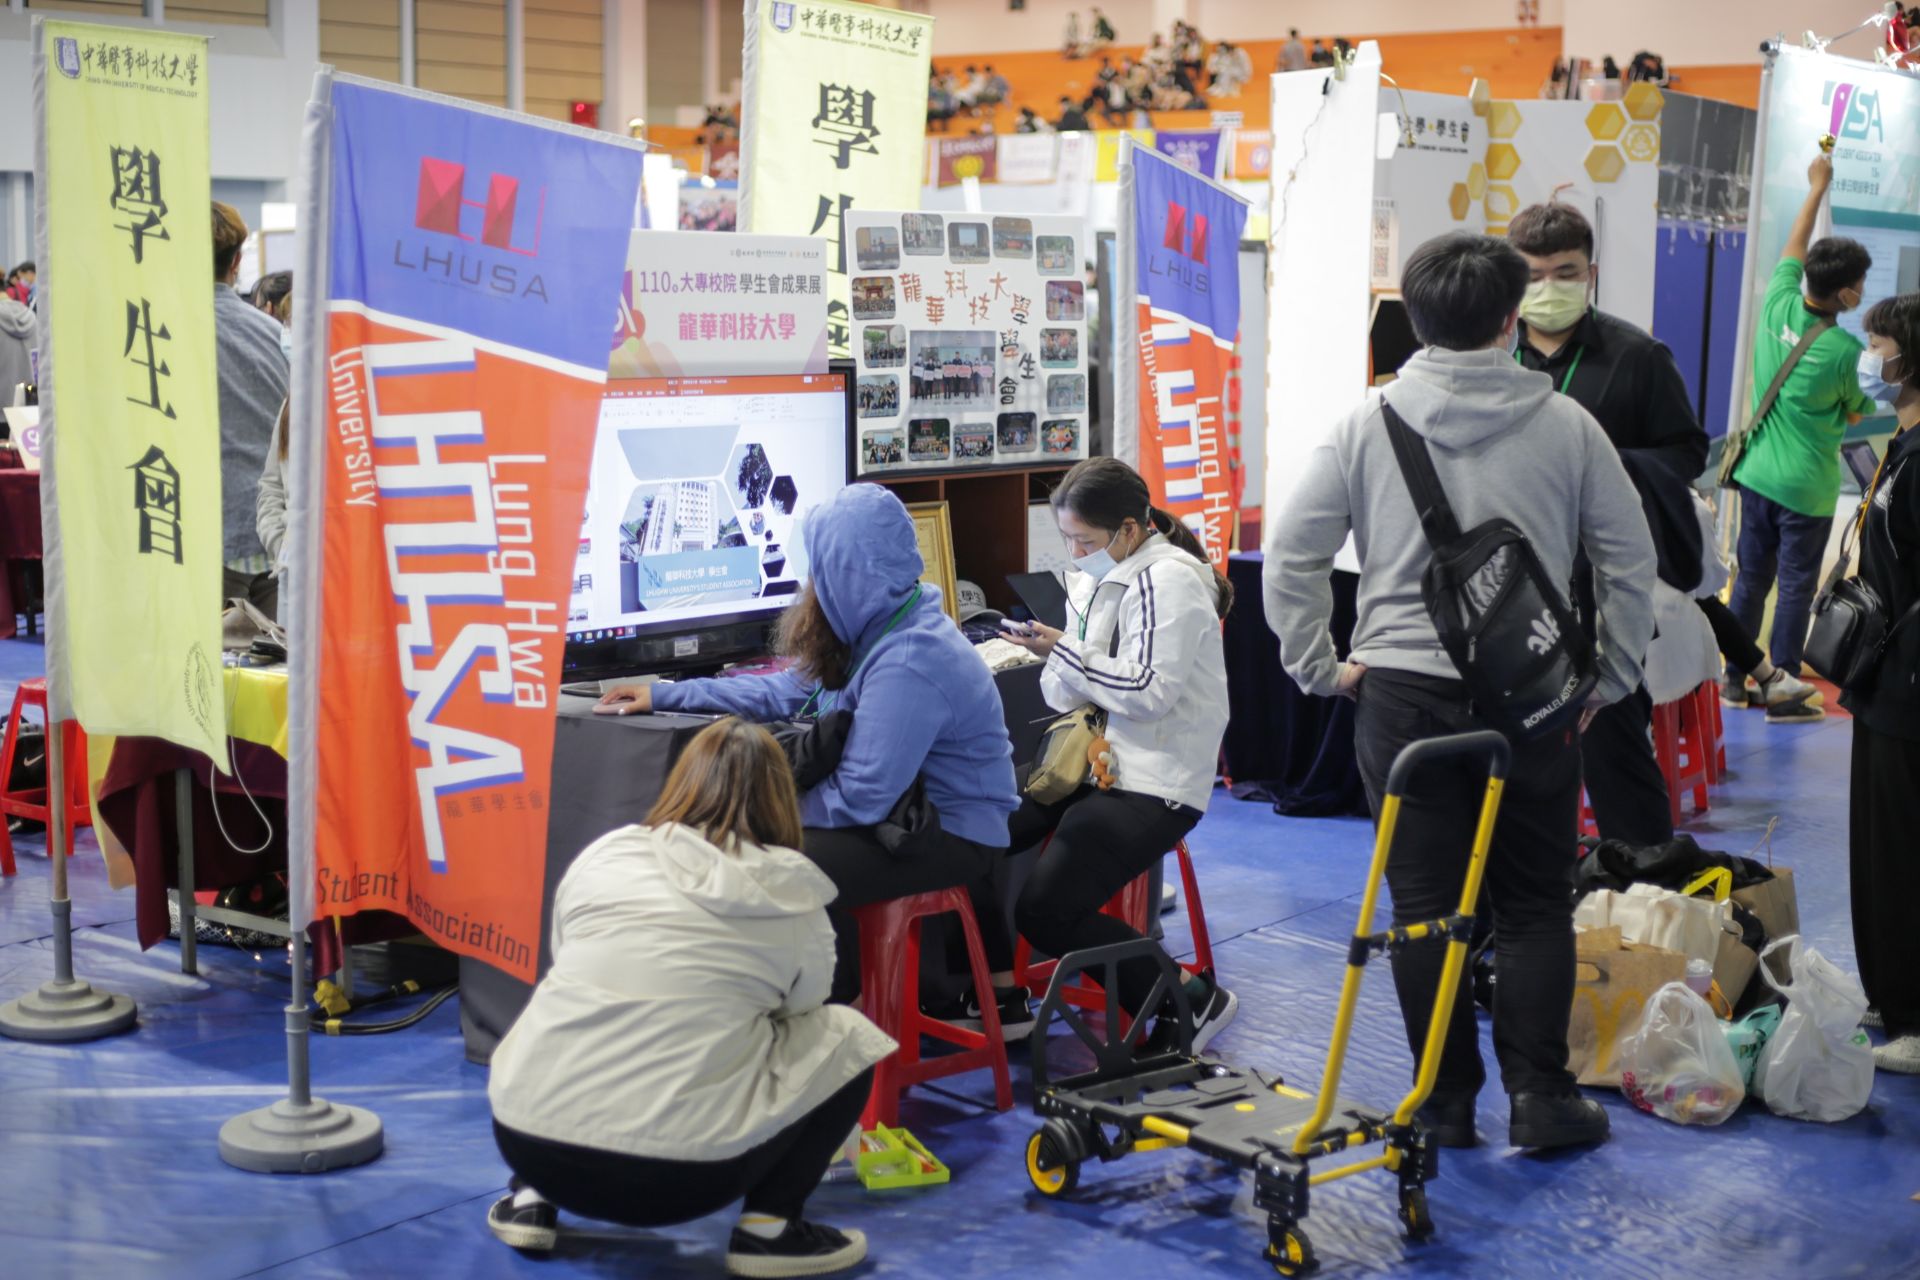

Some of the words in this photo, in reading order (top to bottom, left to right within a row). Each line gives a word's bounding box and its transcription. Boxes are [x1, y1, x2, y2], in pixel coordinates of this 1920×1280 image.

[800, 8, 923, 49] 中華醫事科技大學
[82, 42, 199, 87] 中華醫事科技大學
[394, 239, 549, 304] LHUSA
[739, 273, 822, 295] 學生會成果展
[109, 143, 184, 566] 學生會
[678, 311, 797, 341] 龍華科技大學
[329, 345, 378, 508] University
[1195, 396, 1221, 480] Lung
[488, 454, 547, 577] Lung
[1202, 491, 1231, 565] Hwa
[721, 577, 754, 588] ASSOCIATION
[505, 601, 559, 709] Hwa
